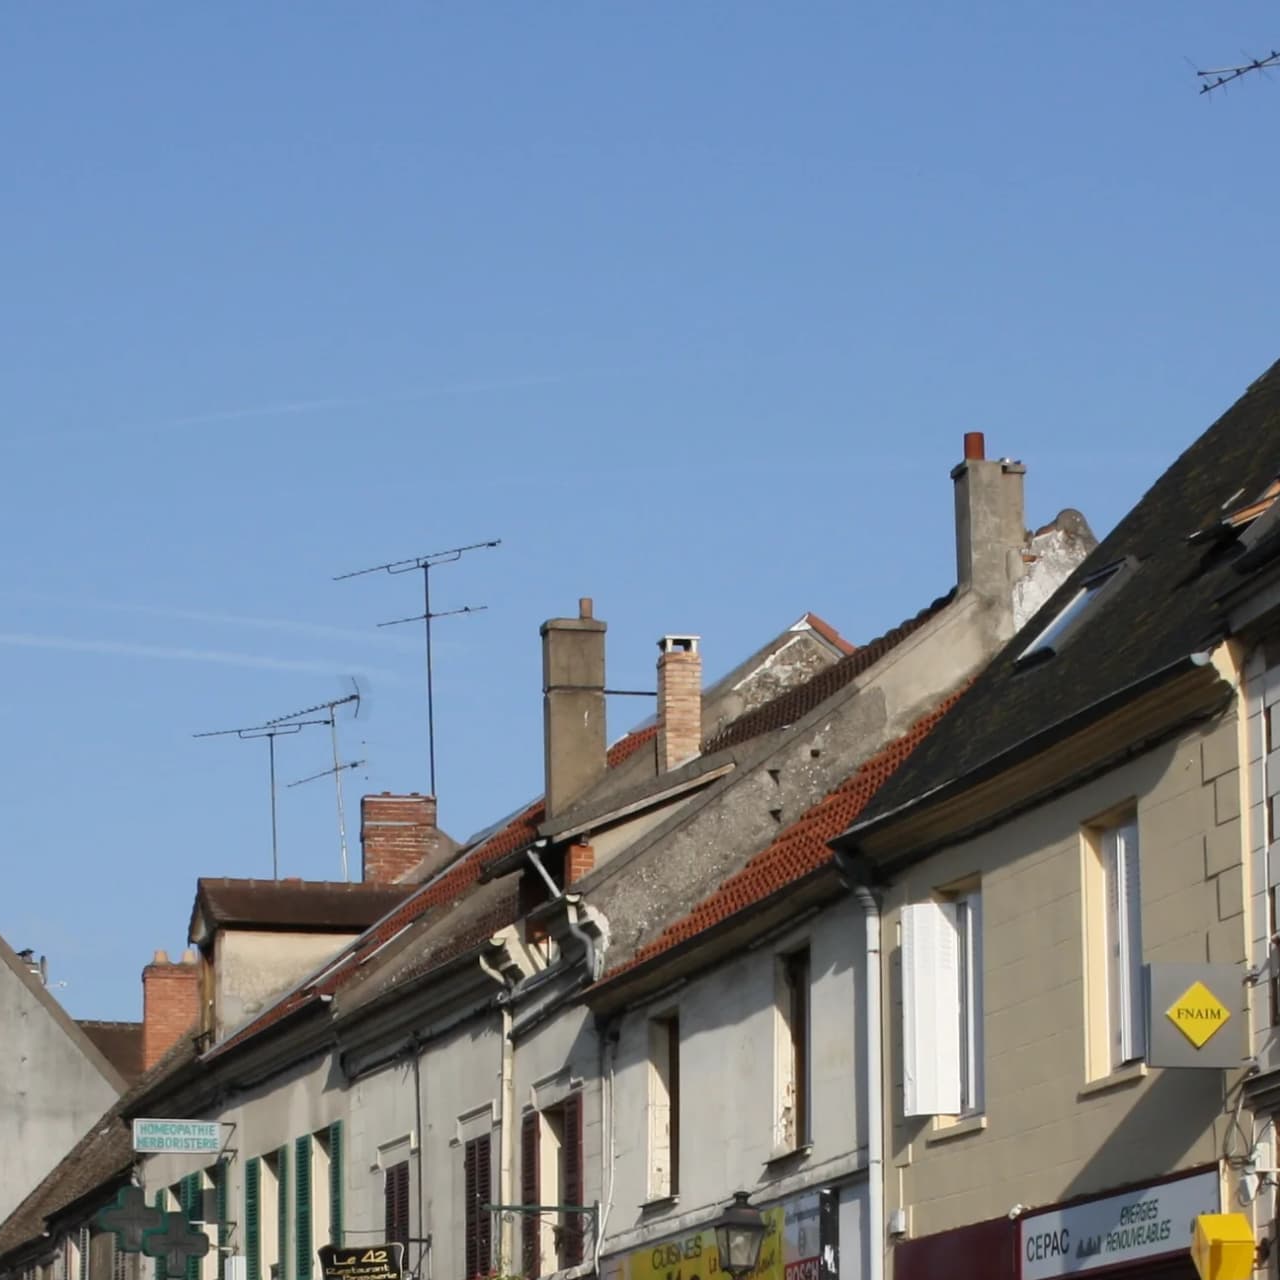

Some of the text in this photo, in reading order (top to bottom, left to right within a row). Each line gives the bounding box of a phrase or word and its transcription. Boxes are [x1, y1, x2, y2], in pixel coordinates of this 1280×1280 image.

[1176, 1007, 1221, 1020] FNAIM
[139, 1123, 217, 1136] HOMEOPATHIE
[136, 1136, 220, 1149] HERBORISTERIE
[1120, 1199, 1159, 1227] ENERGIES
[1105, 1219, 1172, 1252] RENOUVELABLES
[651, 1235, 703, 1271] CUISINES
[1026, 1229, 1070, 1262] CEPAC
[333, 1249, 388, 1265] Le 42
[326, 1263, 390, 1276] Restaurant
